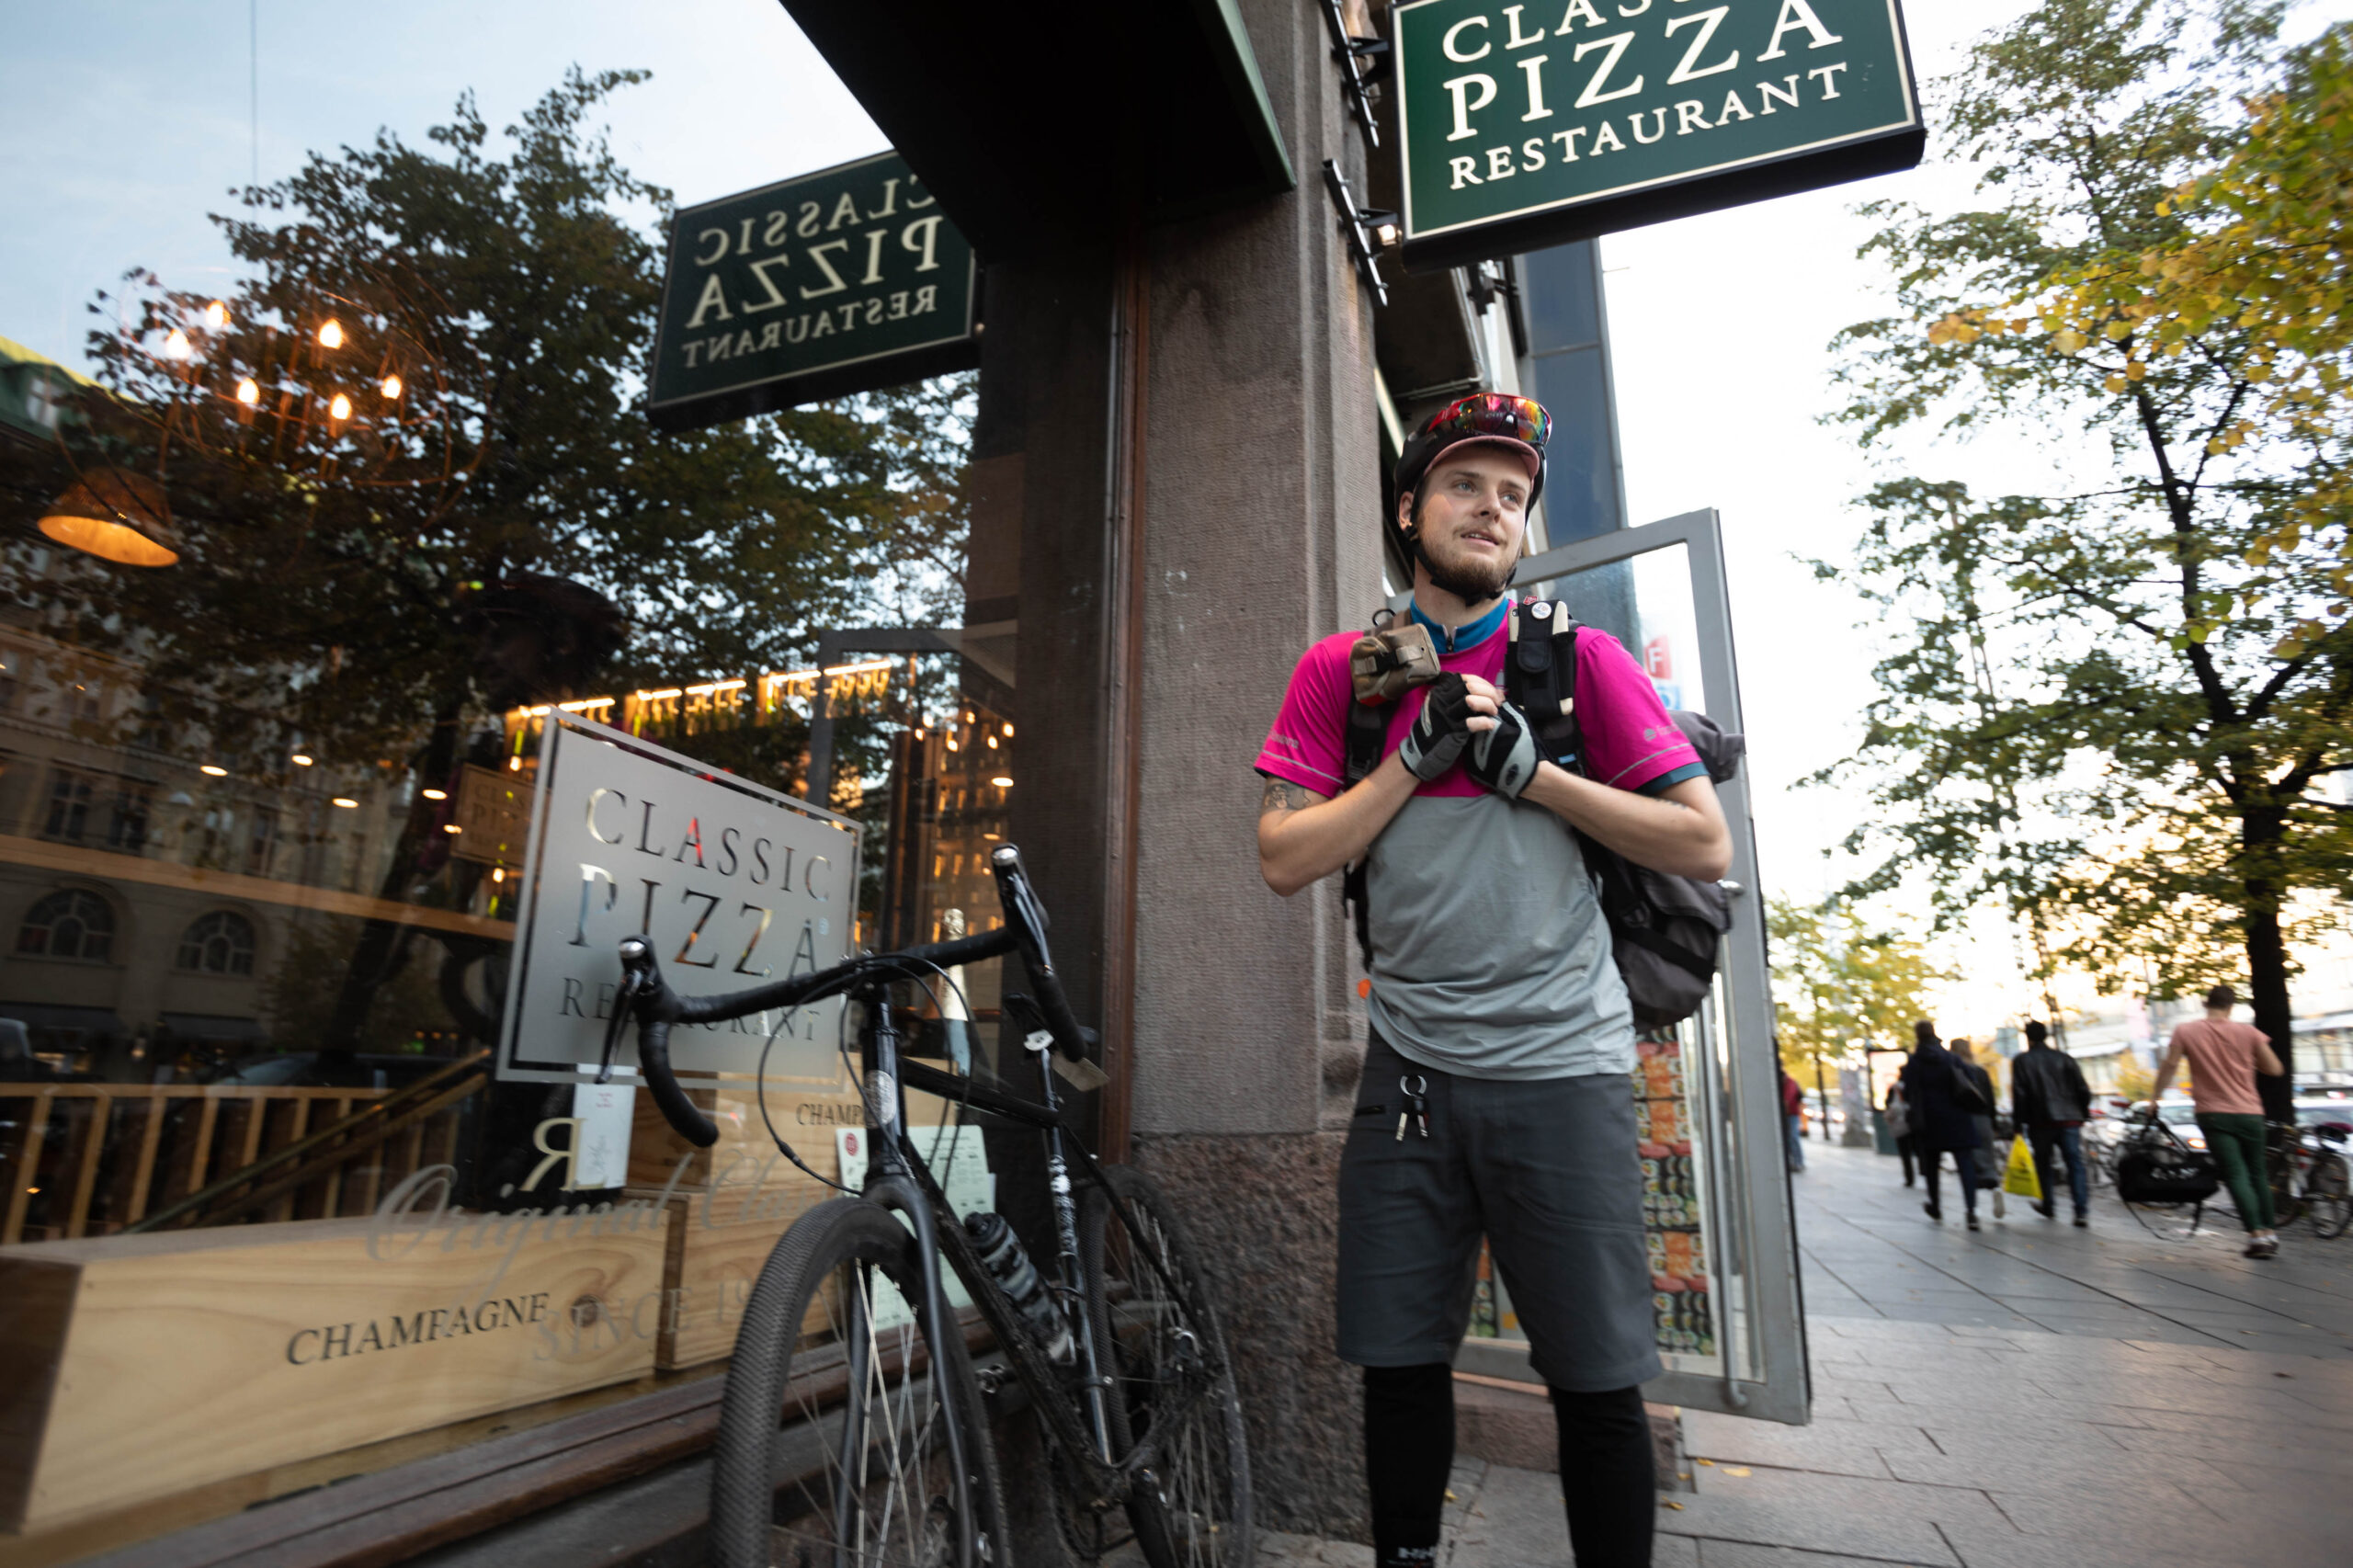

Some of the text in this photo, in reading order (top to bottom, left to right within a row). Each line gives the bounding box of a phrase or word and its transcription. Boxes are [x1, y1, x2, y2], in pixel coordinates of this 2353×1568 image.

[1442, 0, 1692, 62] CLA
[1443, 0, 1843, 142] PIZZA
[1449, 62, 1847, 189] RESTAURANT
[585, 788, 833, 903] CLASSIC
[567, 863, 817, 980] PIZZA
[796, 1102, 867, 1126] CHAMP
[367, 1152, 697, 1336] Original
[533, 1287, 693, 1361] SINCE
